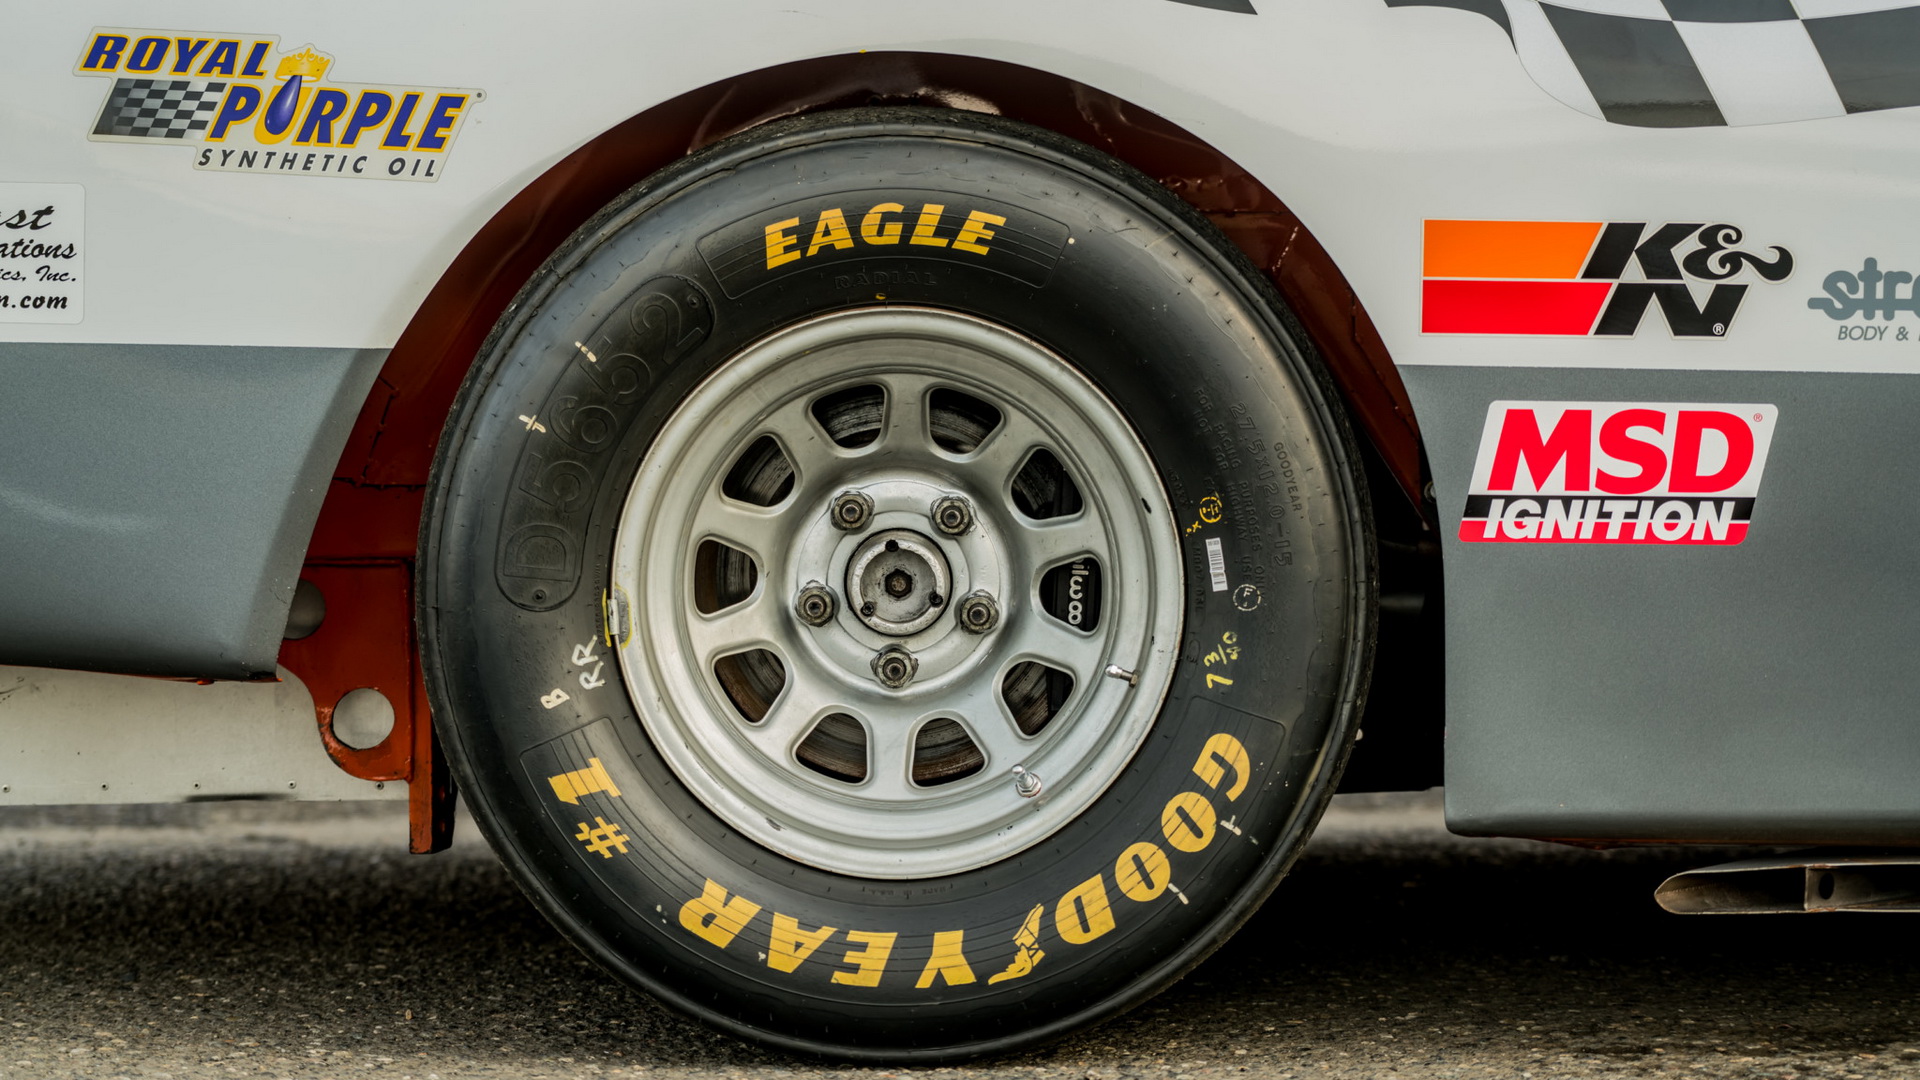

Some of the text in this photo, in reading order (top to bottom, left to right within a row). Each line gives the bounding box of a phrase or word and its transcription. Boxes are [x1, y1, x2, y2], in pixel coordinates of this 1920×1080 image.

[80, 33, 273, 77] ROYAL
[205, 83, 470, 152] PURPLE
[198, 148, 436, 177] SYNTHETIC OIL
[0, 205, 55, 230] st
[765, 203, 1007, 270] EAGLE
[35, 265, 76, 282] Inc.
[834, 271, 938, 289] RADIAL
[1838, 325, 1909, 341] BODY &
[503, 293, 703, 583] D5652
[1193, 384, 1214, 412] FOR
[1213, 422, 1242, 471] RACING
[1487, 408, 1755, 494] MSD
[1273, 441, 1303, 512] GOODYEAR
[1482, 498, 1736, 541] IGNITION
[571, 634, 607, 690] RR
[540, 687, 570, 710] B
[547, 756, 631, 859] #1
